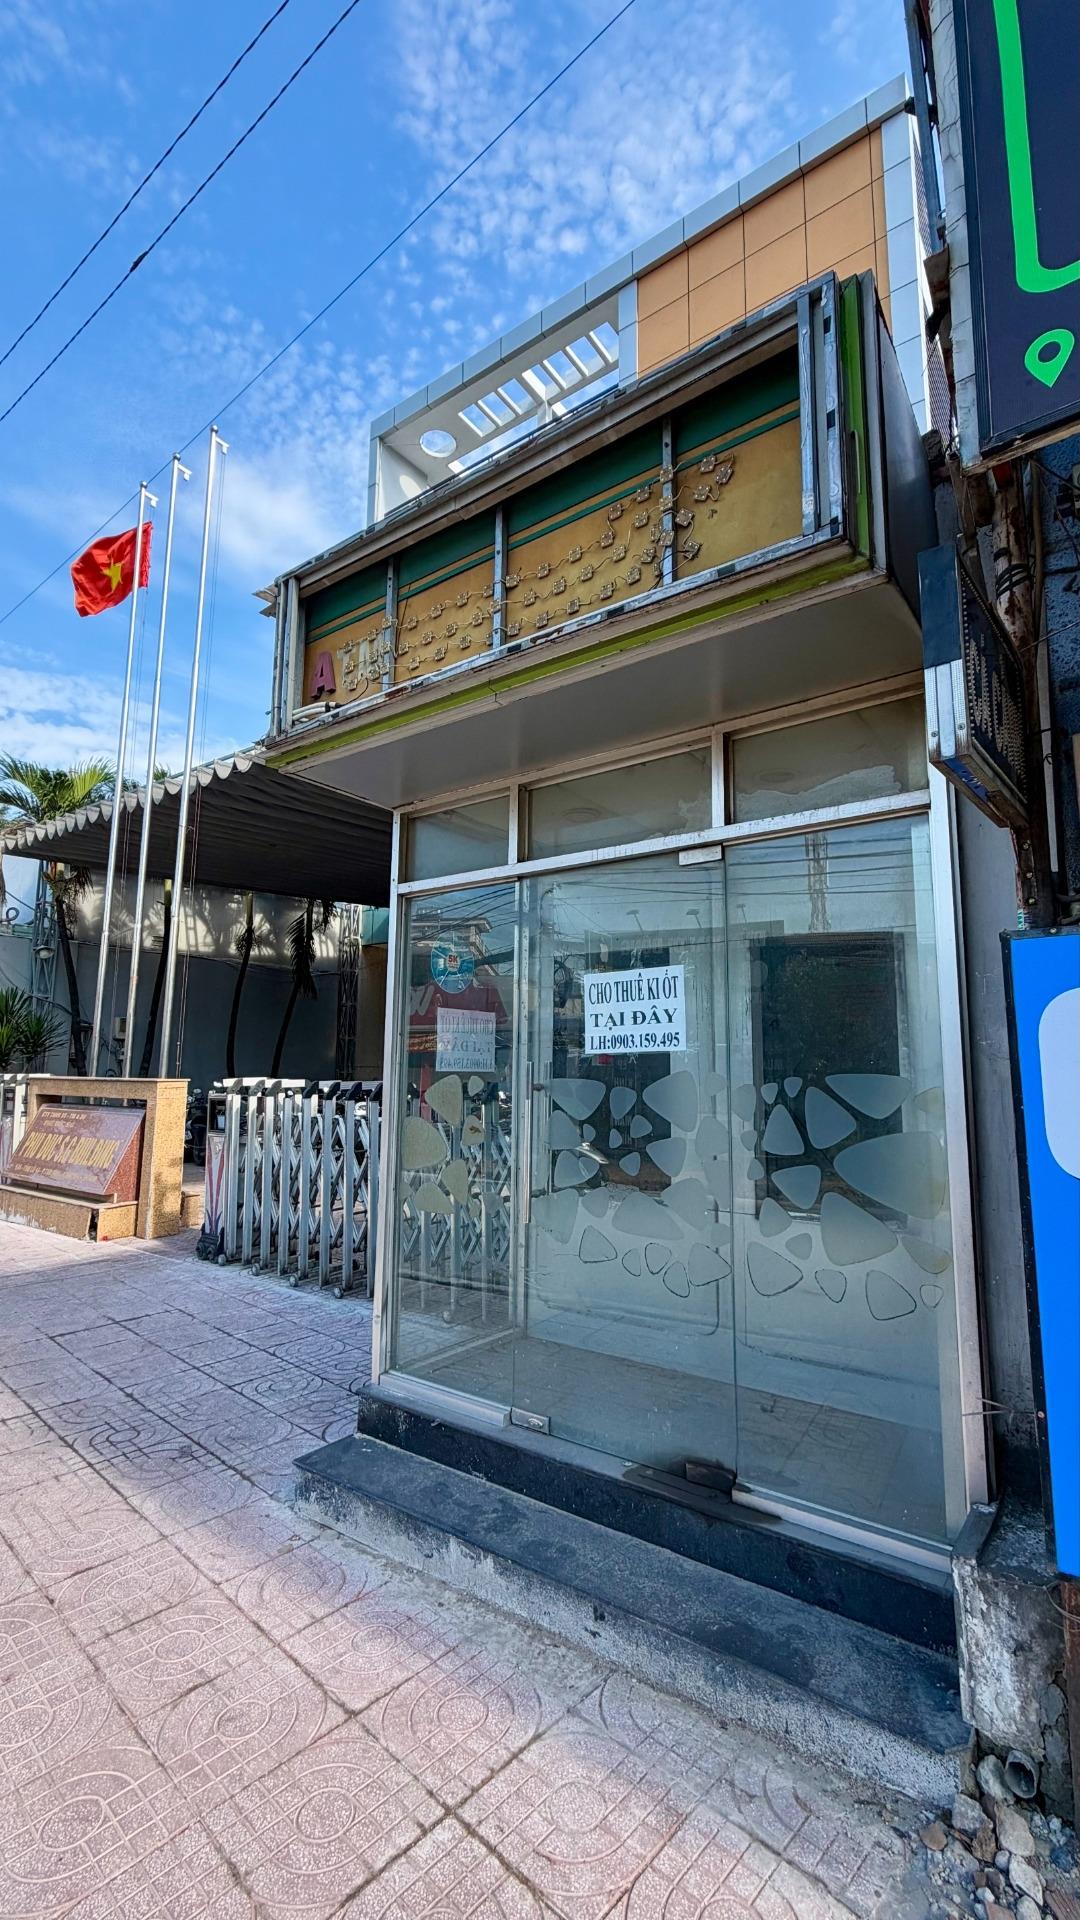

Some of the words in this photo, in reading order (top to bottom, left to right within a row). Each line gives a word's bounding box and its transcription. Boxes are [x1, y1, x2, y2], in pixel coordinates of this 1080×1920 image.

[588, 982, 612, 1005] CHO
[613, 972, 645, 1003] THUÊ
[647, 977, 661, 1001] KI
[662, 969, 679, 999] ỐT
[589, 1011, 626, 1031] TẠI
[631, 1004, 678, 1025] ĐÂY
[590, 1032, 680, 1050] LH:0903.159.495
